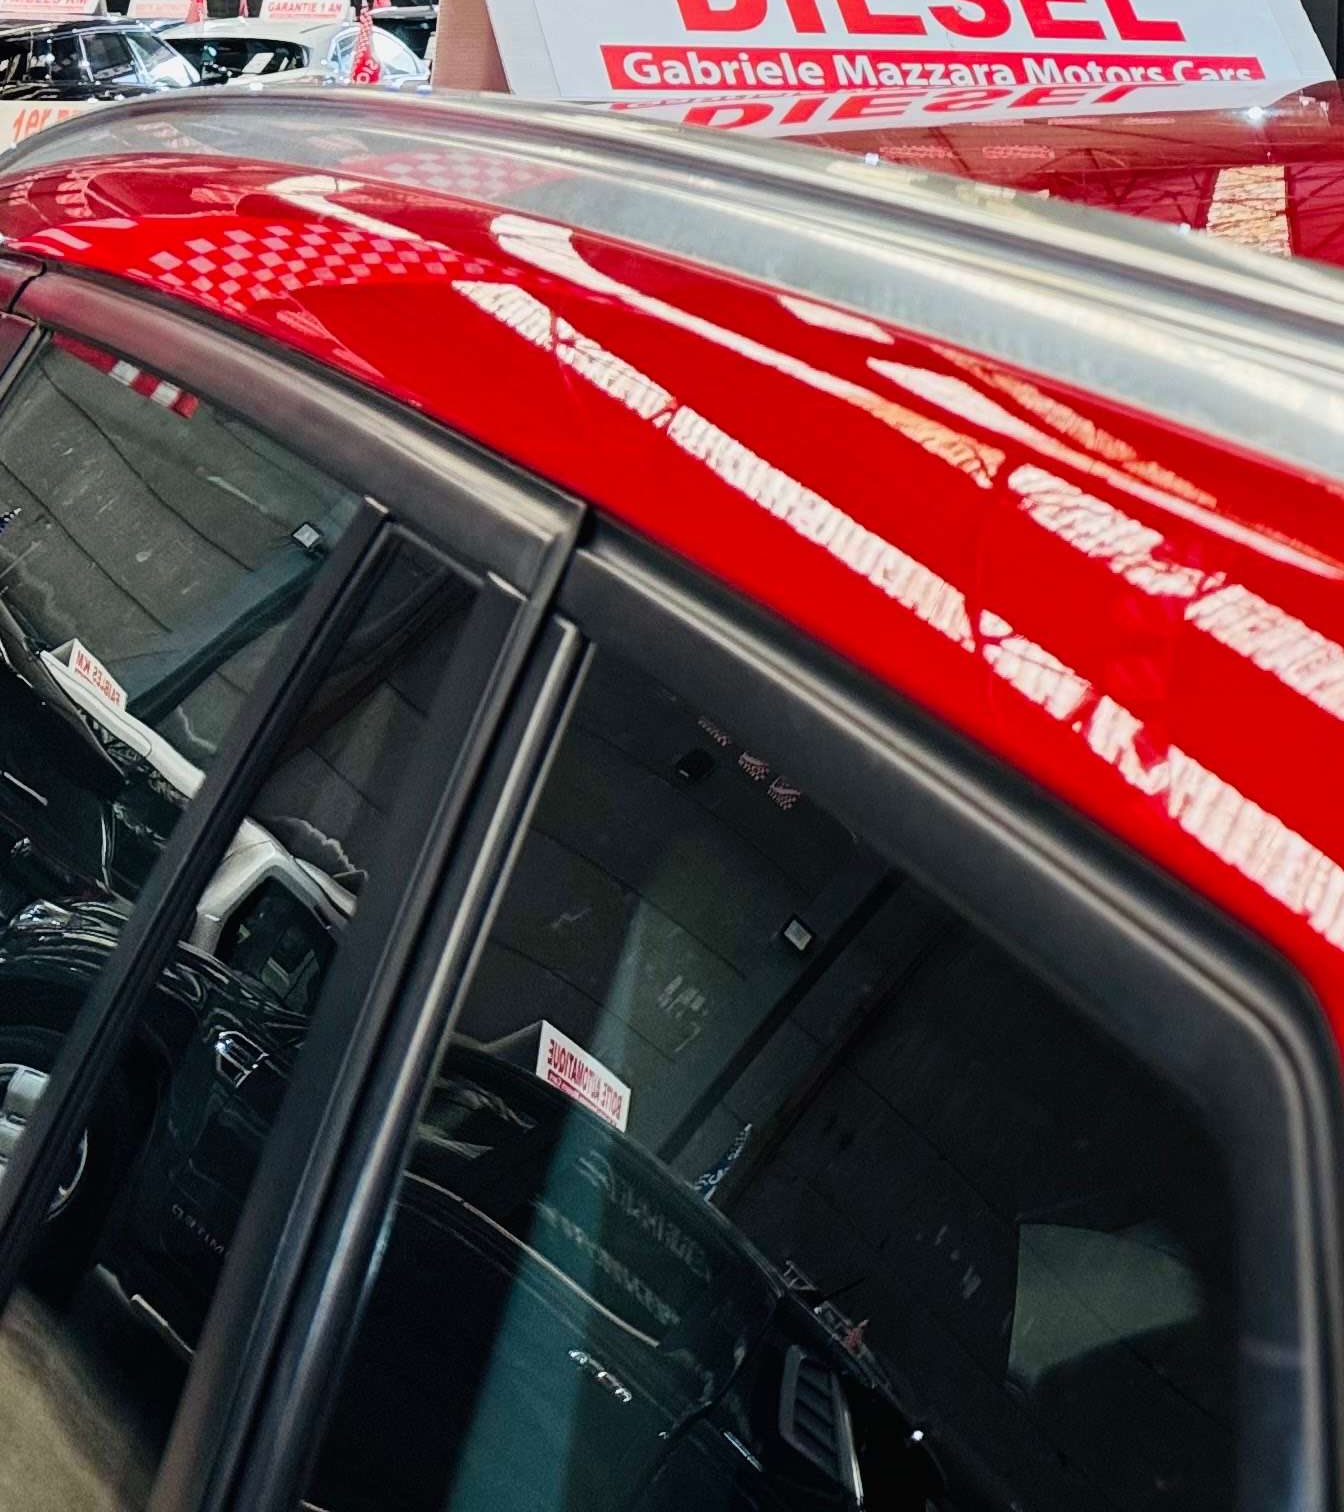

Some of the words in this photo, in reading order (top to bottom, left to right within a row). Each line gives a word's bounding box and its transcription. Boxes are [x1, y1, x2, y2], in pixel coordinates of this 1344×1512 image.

[267, 2, 316, 13] GARANTIE
[623, 51, 825, 86] Gabriele
[832, 54, 1017, 86] Mazzara
[1022, 57, 1167, 86] Motors
